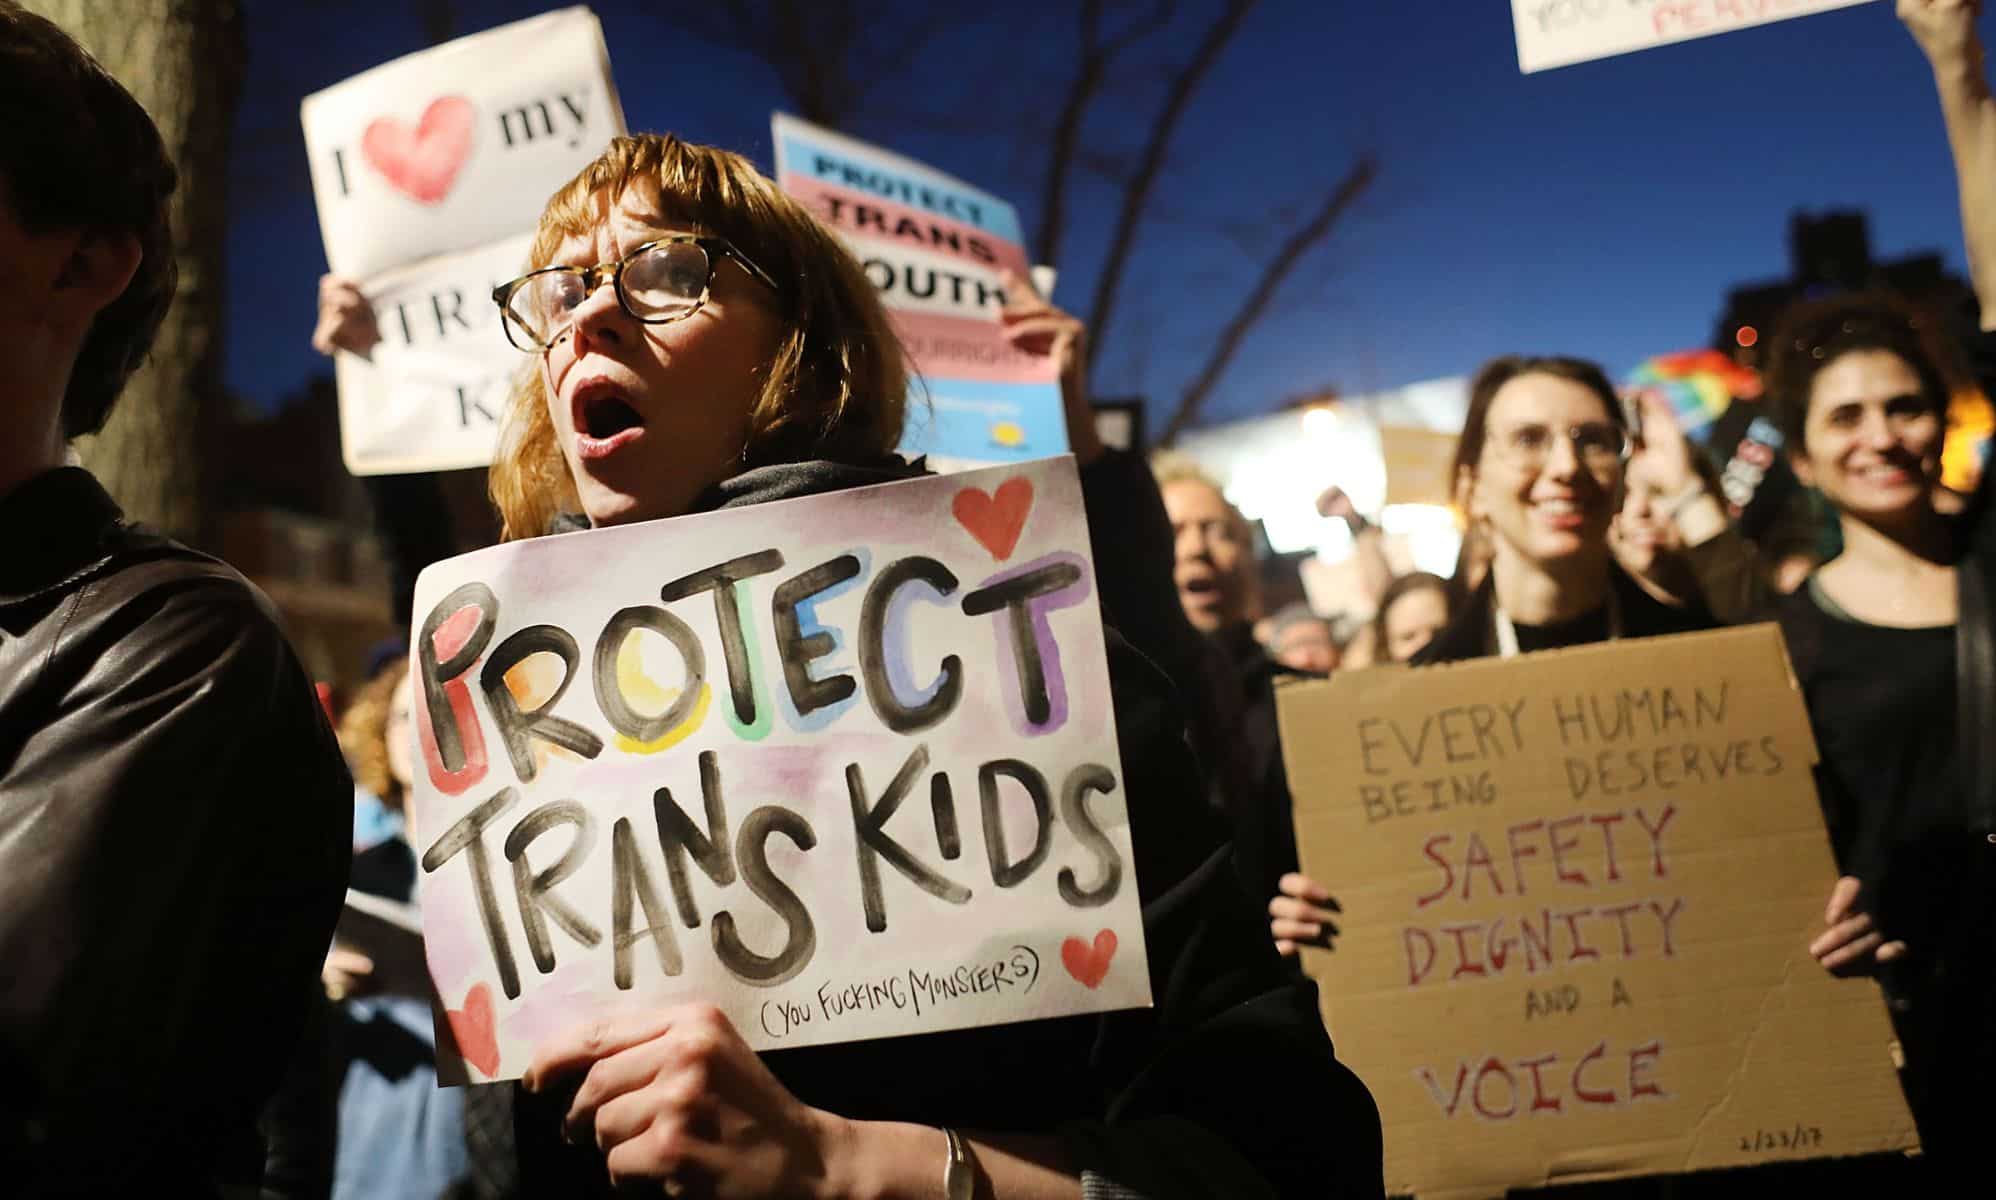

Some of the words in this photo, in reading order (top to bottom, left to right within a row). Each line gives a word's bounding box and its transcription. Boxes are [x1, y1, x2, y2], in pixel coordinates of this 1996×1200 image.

[332, 145, 351, 200] I
[496, 83, 596, 150] my
[811, 154, 986, 227] PROTECT
[822, 191, 998, 265] TRANS
[861, 257, 1007, 306] OUTH
[416, 547, 1091, 797] PROTECT
[1357, 697, 1528, 777] EVERY
[1553, 680, 1730, 747] HUMAN
[1358, 769, 1497, 825] BEING
[1563, 735, 1786, 802] DESERVES
[421, 750, 817, 1001] TRANS
[844, 743, 1124, 934] KIDS
[1415, 803, 1680, 908] SAFETY
[1401, 897, 1687, 988] DIGNITY
[816, 976, 907, 1022] FUCKING
[1523, 983, 1580, 1022] AND
[1610, 976, 1633, 1009] A
[1417, 1039, 1668, 1131] VOICE
